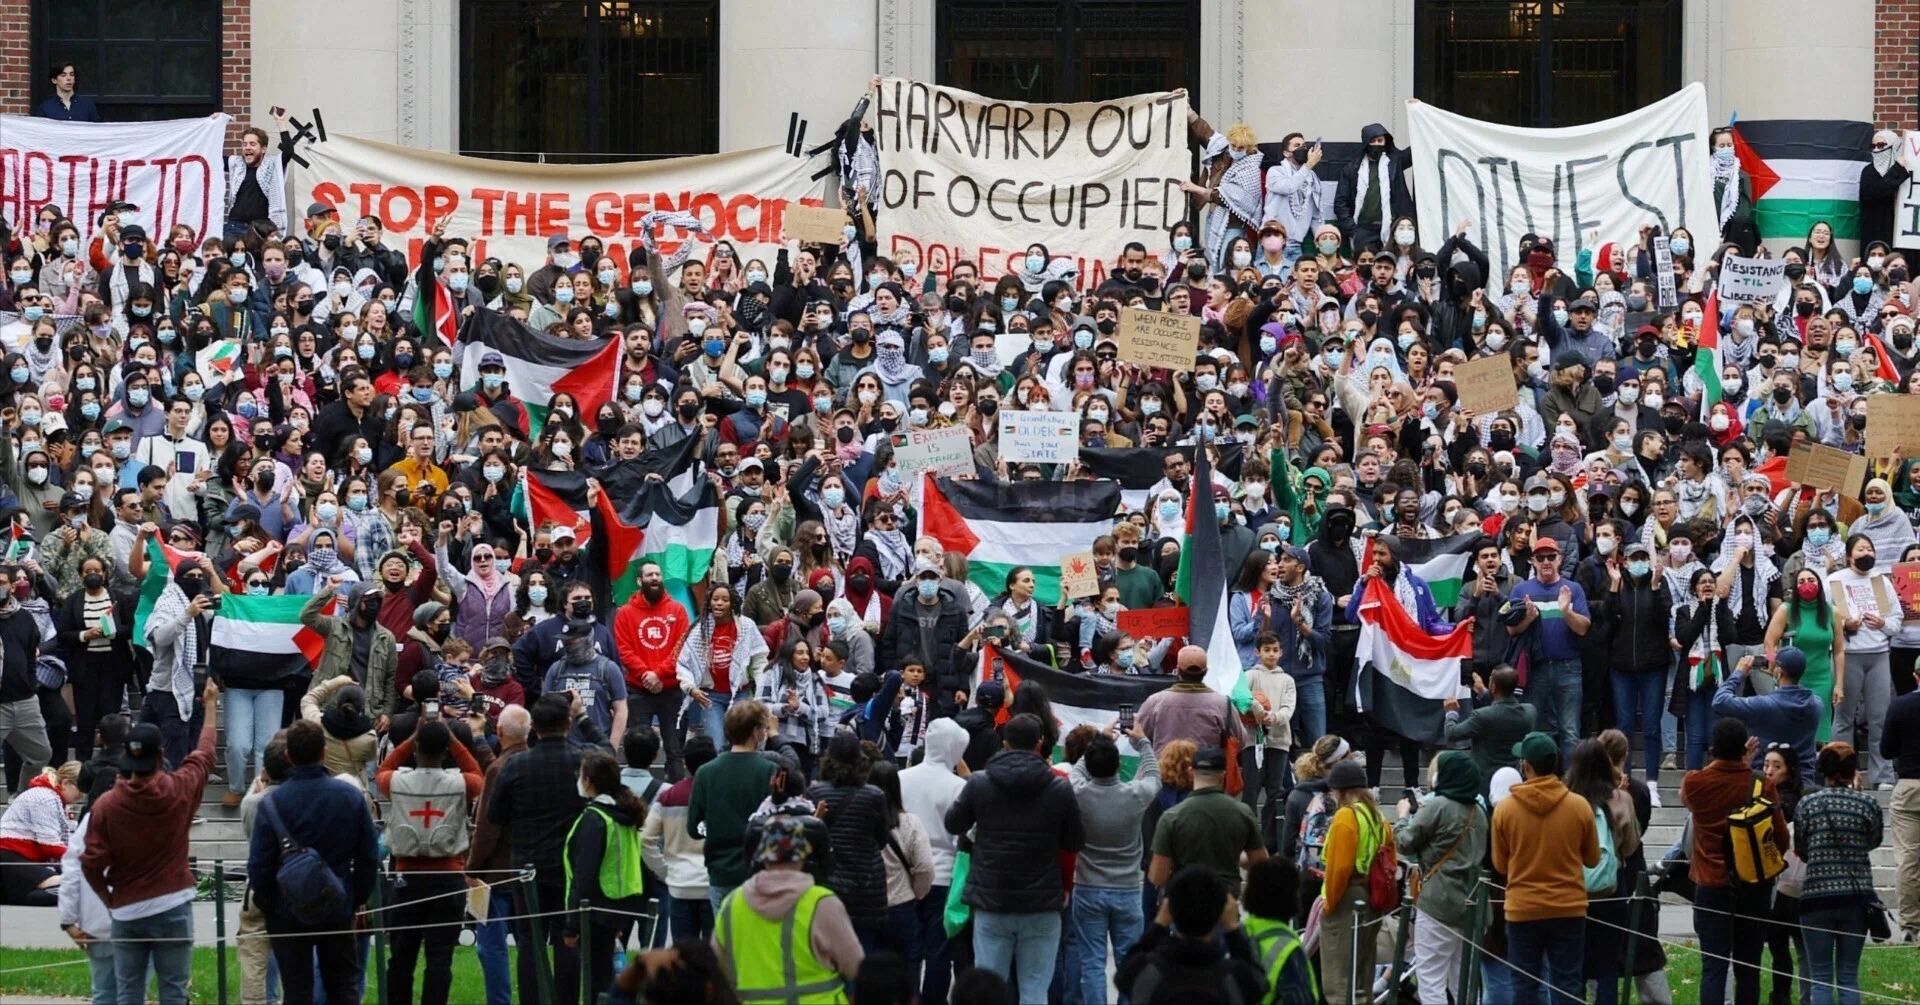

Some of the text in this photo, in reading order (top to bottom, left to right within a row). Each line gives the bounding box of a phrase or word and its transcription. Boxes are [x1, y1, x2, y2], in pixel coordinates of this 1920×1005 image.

[877, 81, 1186, 160] HARVARD OUT
[883, 169, 1191, 232] OF OCCUPIED
[304, 182, 460, 238] STOP
[472, 188, 572, 238] THE
[1160, 316, 1189, 331] PEOPLE
[1135, 325, 1192, 341] ARE OCCUPIED
[1131, 337, 1178, 351] RESISTANCE
[1134, 350, 1192, 365] IS JUSTIFIED
[1018, 425, 1057, 438] OLDER
[927, 443, 940, 453] IS
